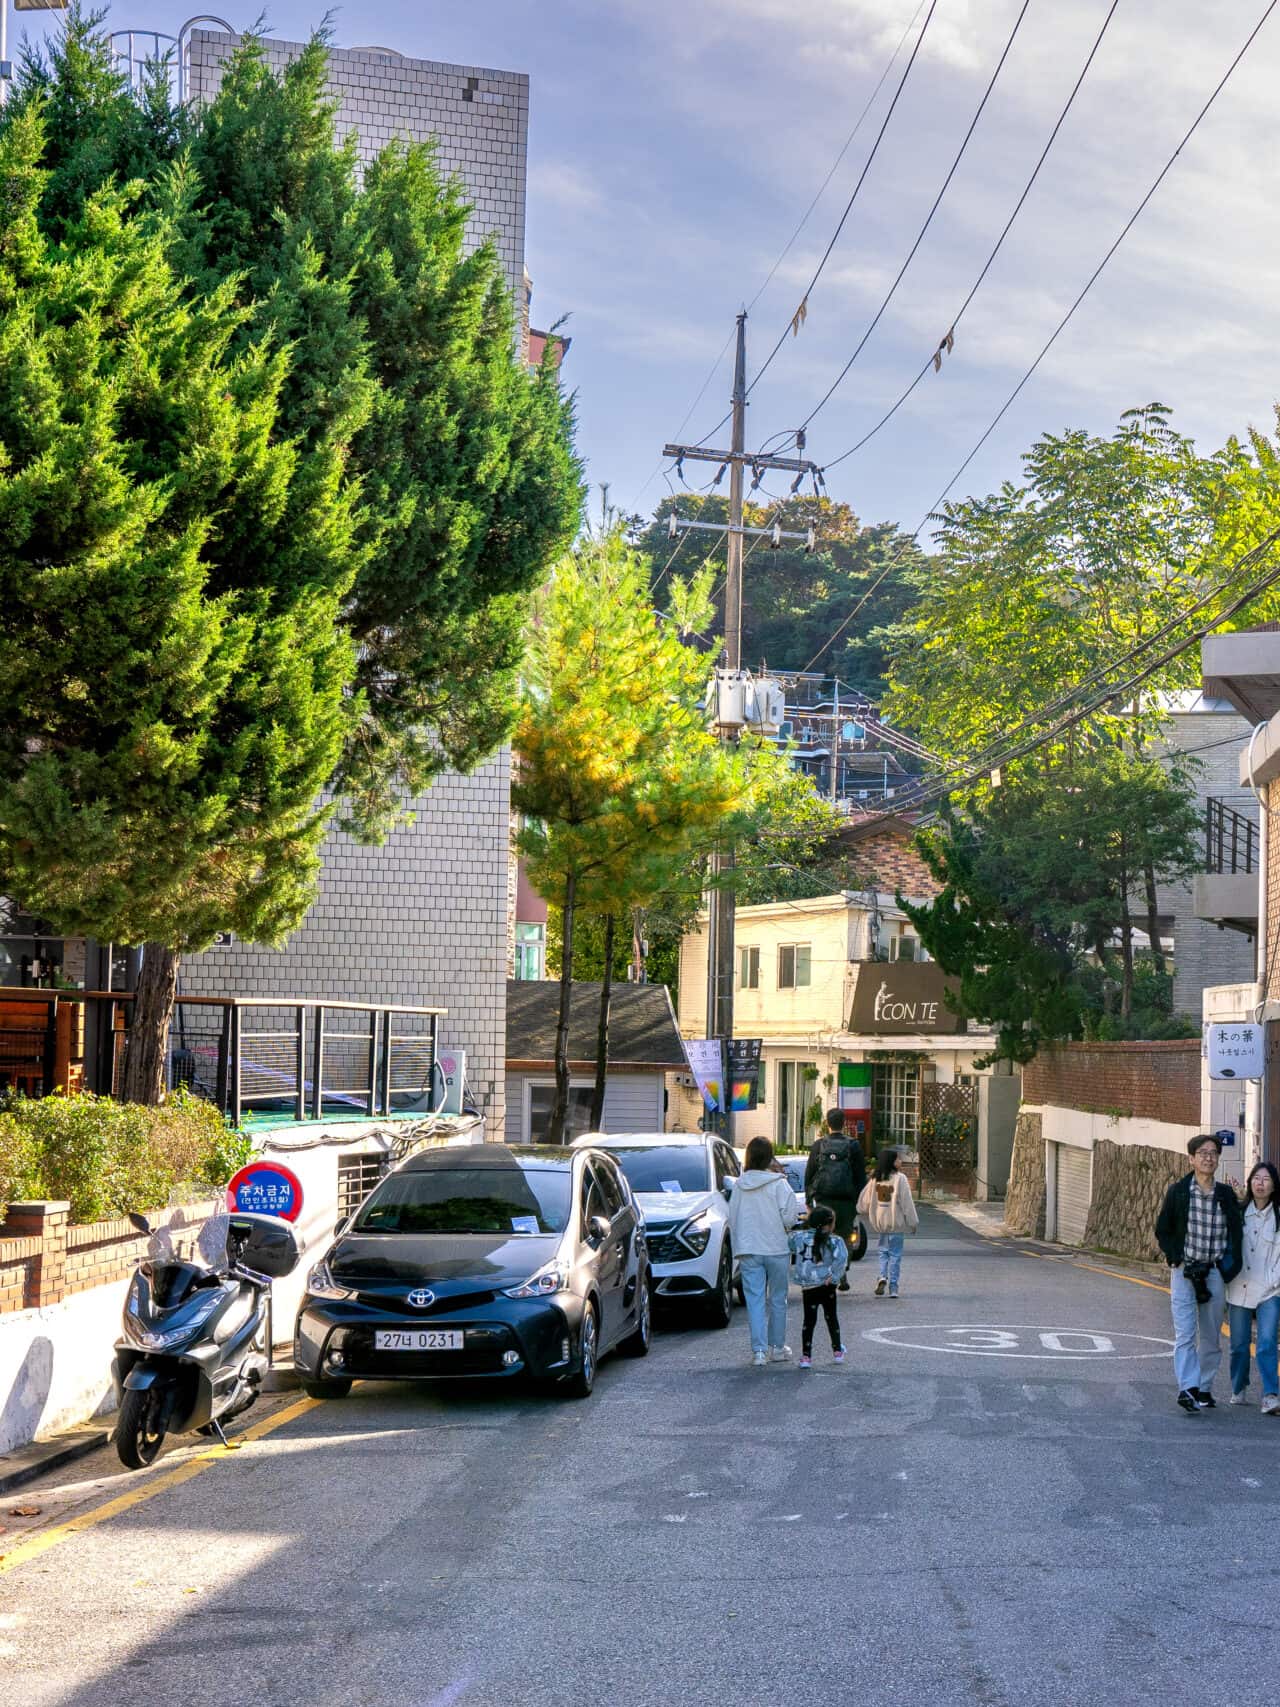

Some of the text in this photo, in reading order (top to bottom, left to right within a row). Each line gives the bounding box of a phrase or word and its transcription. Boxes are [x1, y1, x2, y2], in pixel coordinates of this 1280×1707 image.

[240, 1184, 290, 1197] 주차금지
[383, 1333, 455, 1348] 27너 0231
[945, 1328, 1116, 1353] 30
